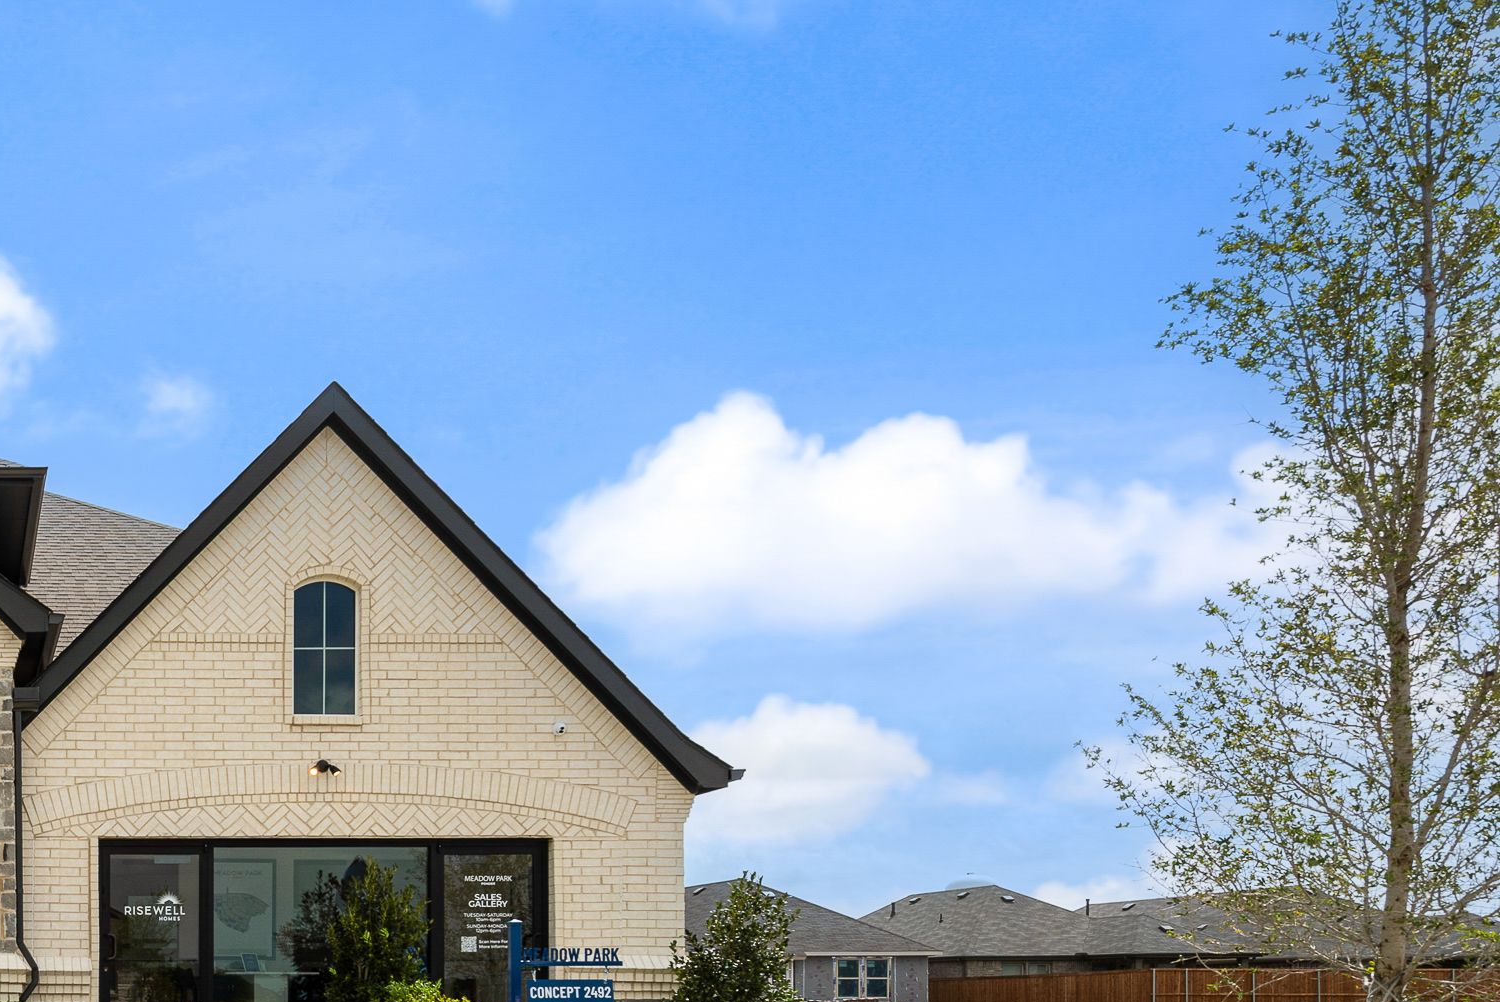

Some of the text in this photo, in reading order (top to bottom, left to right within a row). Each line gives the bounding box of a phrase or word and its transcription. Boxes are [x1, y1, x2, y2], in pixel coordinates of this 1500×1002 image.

[474, 893, 502, 901] SALES
[468, 900, 508, 908] GALLERY
[124, 905, 186, 916] RISEWELL
[584, 947, 619, 961] PARK
[529, 986, 612, 999] CONCEPT 2492
